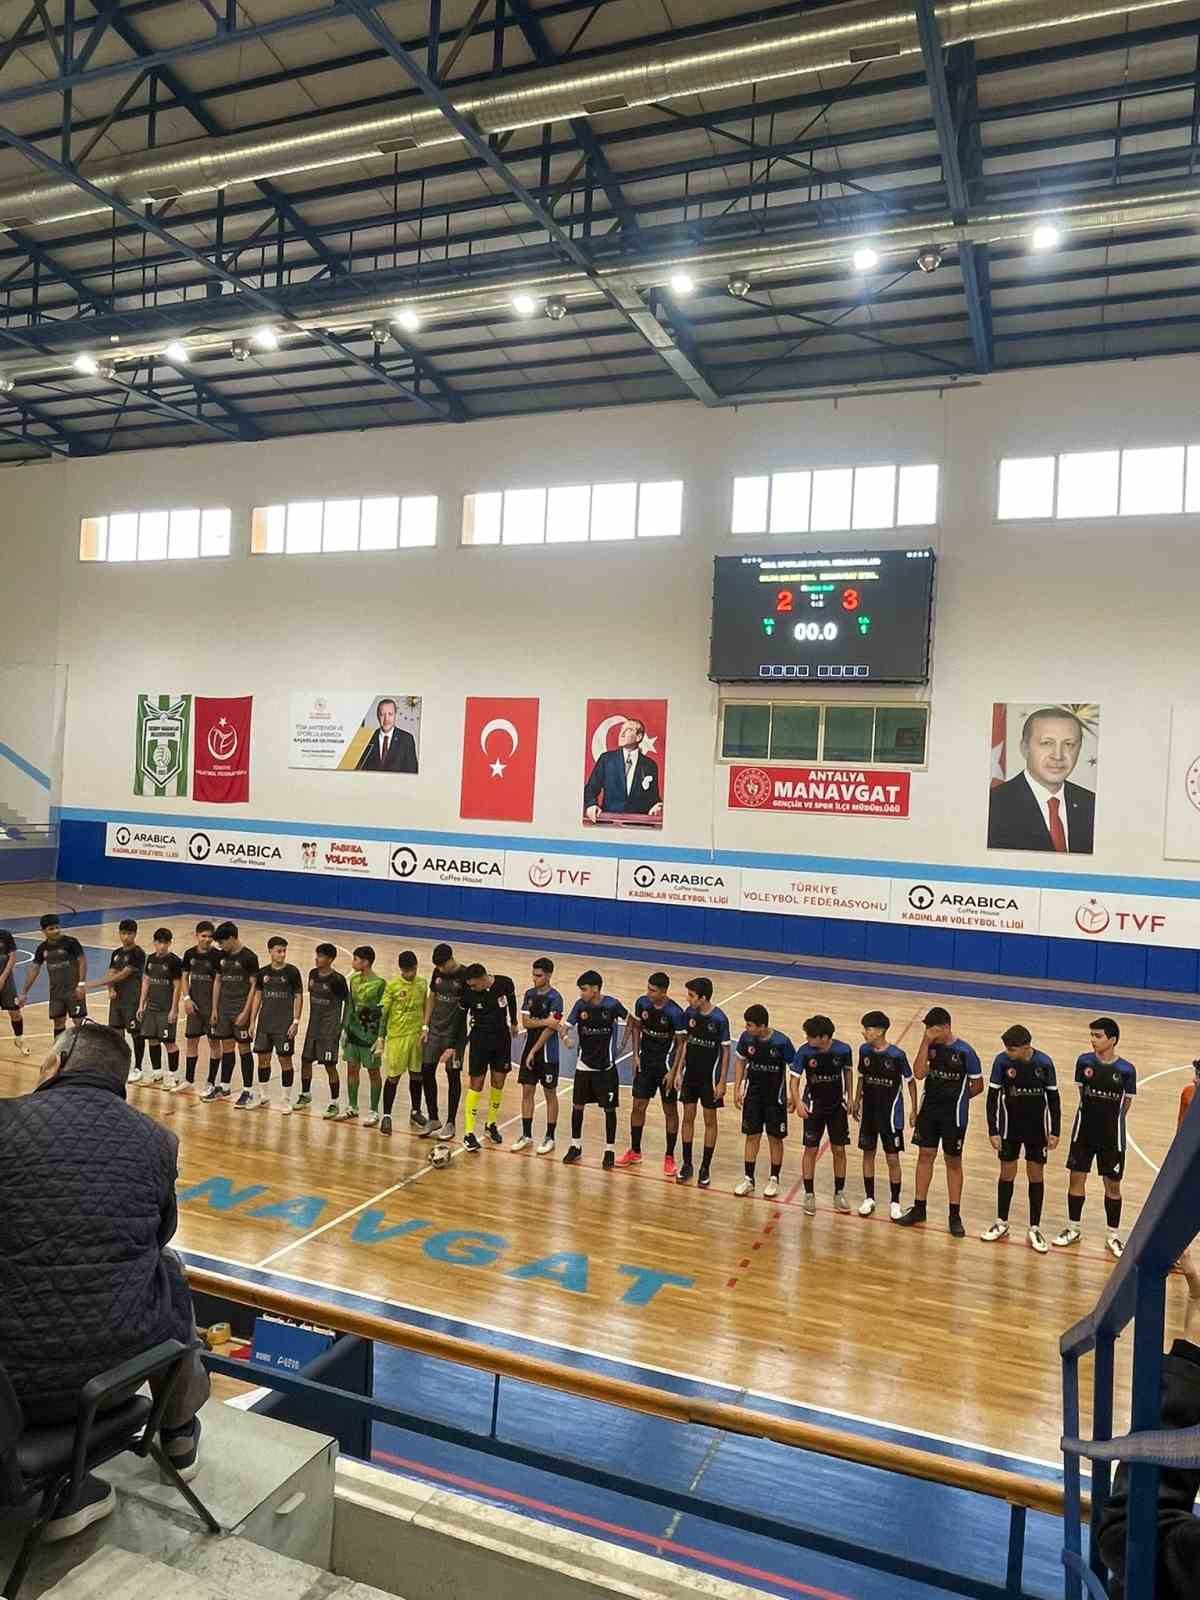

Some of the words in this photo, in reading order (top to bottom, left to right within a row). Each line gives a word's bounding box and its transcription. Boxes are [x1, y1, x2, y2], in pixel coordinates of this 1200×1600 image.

[777, 591, 793, 611] 2
[843, 588, 859, 610] 3
[793, 622, 838, 641] 00.0
[808, 770, 866, 783] ANTALYA
[773, 781, 901, 803] MANAVGAT
[772, 799, 803, 808] GENÇLİK
[814, 801, 834, 809] SPOR
[835, 802, 850, 810] İLÇE
[851, 803, 901, 813] MÜDÜRLÜĞÜ
[133, 833, 177, 844] ARABICA
[215, 842, 282, 859] ARABICA
[324, 853, 369, 867] VOLEYBOL
[422, 857, 502, 876] ARABICA
[556, 869, 592, 886] TVF
[660, 873, 725, 887] ARABICA
[628, 890, 667, 899] KADINLAR
[668, 893, 706, 903] VOLEYBOL
[791, 882, 838, 895] TÜRKİYE
[743, 891, 800, 905] VOLEYBOL
[802, 896, 888, 911] FEDERASYONU
[940, 894, 1019, 910] ARABICA
[902, 912, 949, 923] KADINLAR
[949, 916, 998, 928] VOLEYBOL
[1115, 912, 1167, 933] TVF
[607, 1092, 614, 1103] 7
